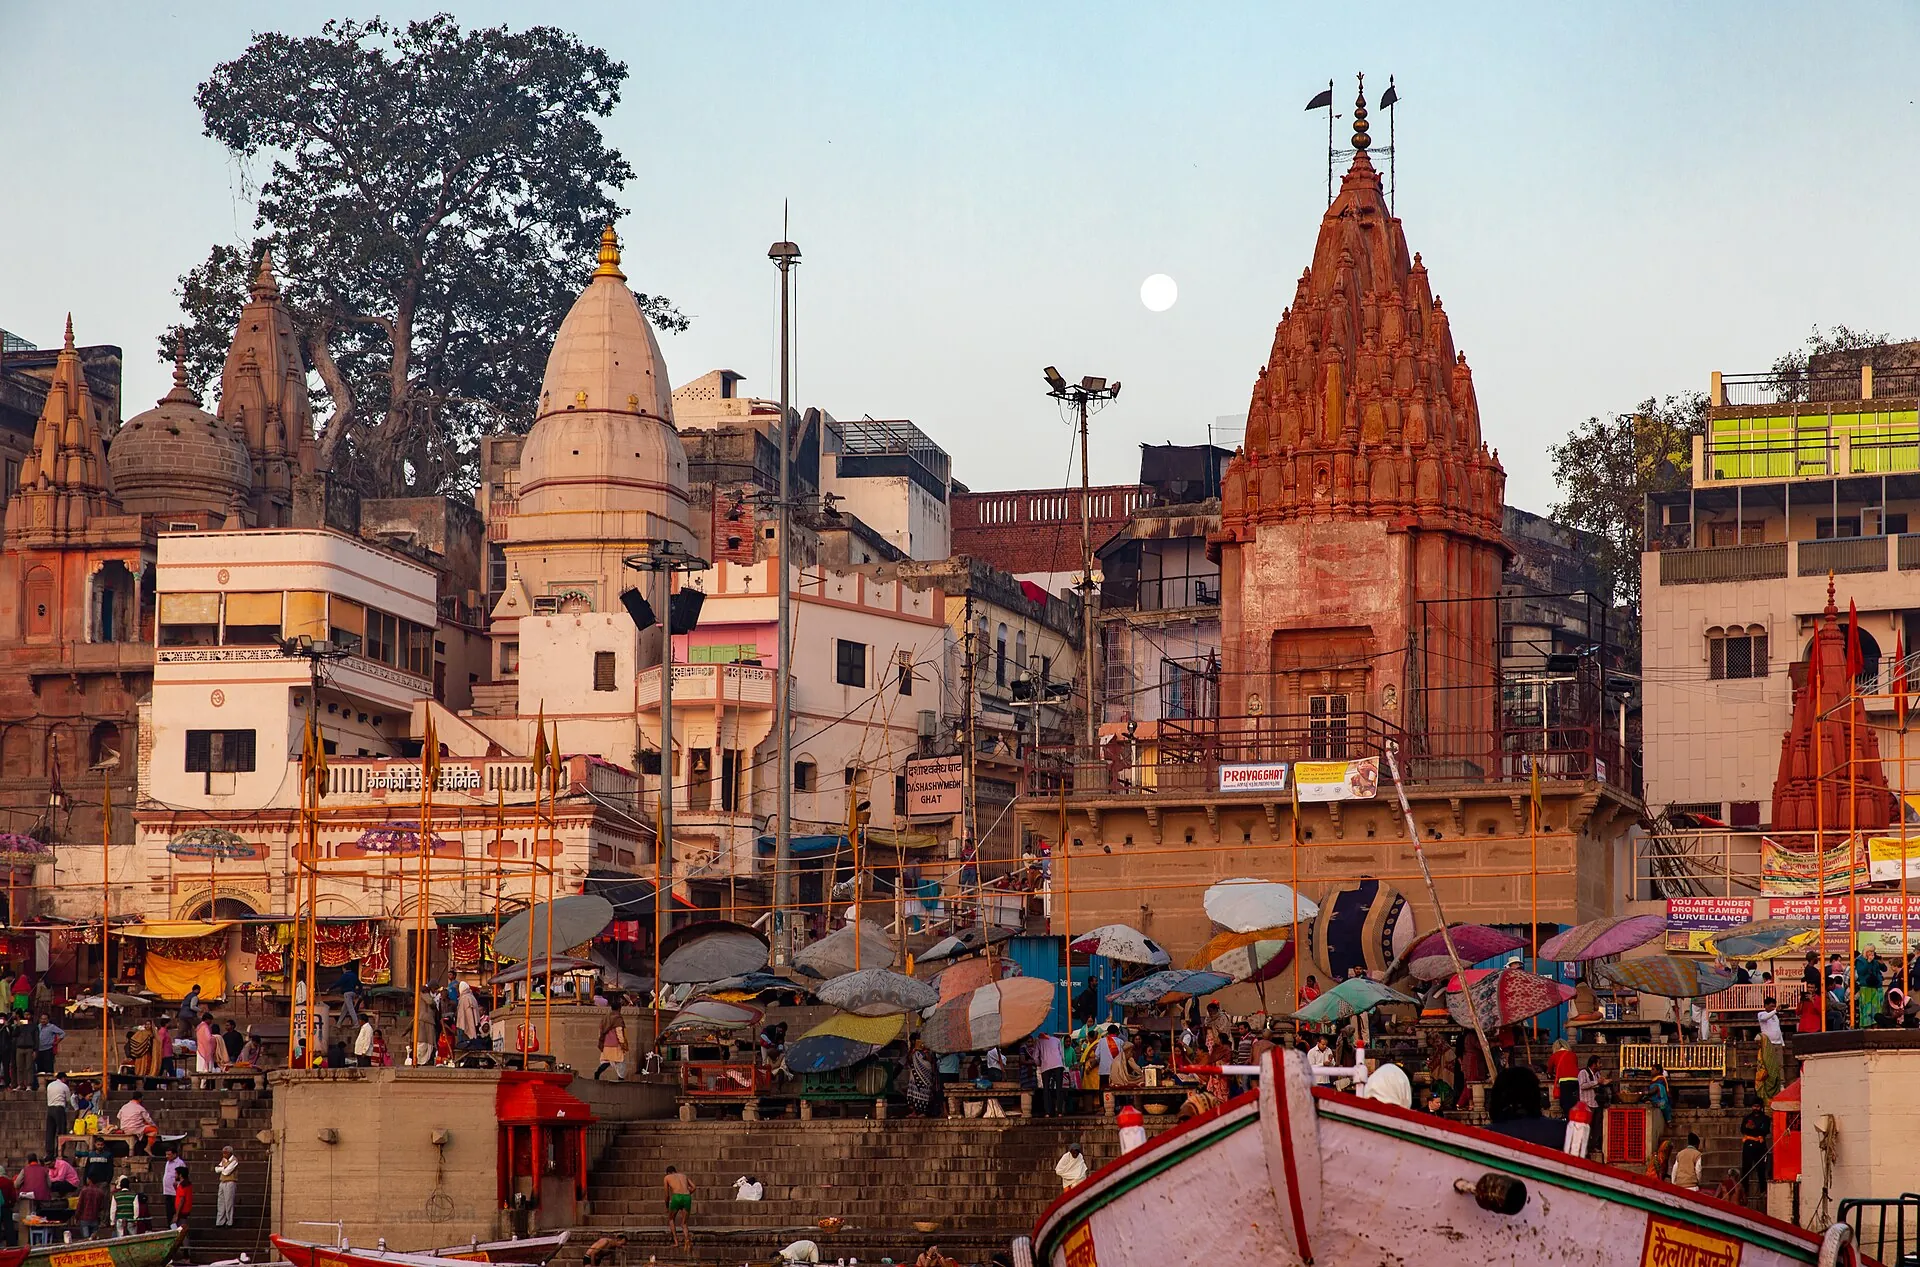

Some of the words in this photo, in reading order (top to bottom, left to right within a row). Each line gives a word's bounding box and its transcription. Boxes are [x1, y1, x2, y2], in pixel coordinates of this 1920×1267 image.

[443, 771, 481, 789] समिति
[921, 795, 942, 804] GHAT
[1672, 913, 1748, 922] SURVEILLANCE
